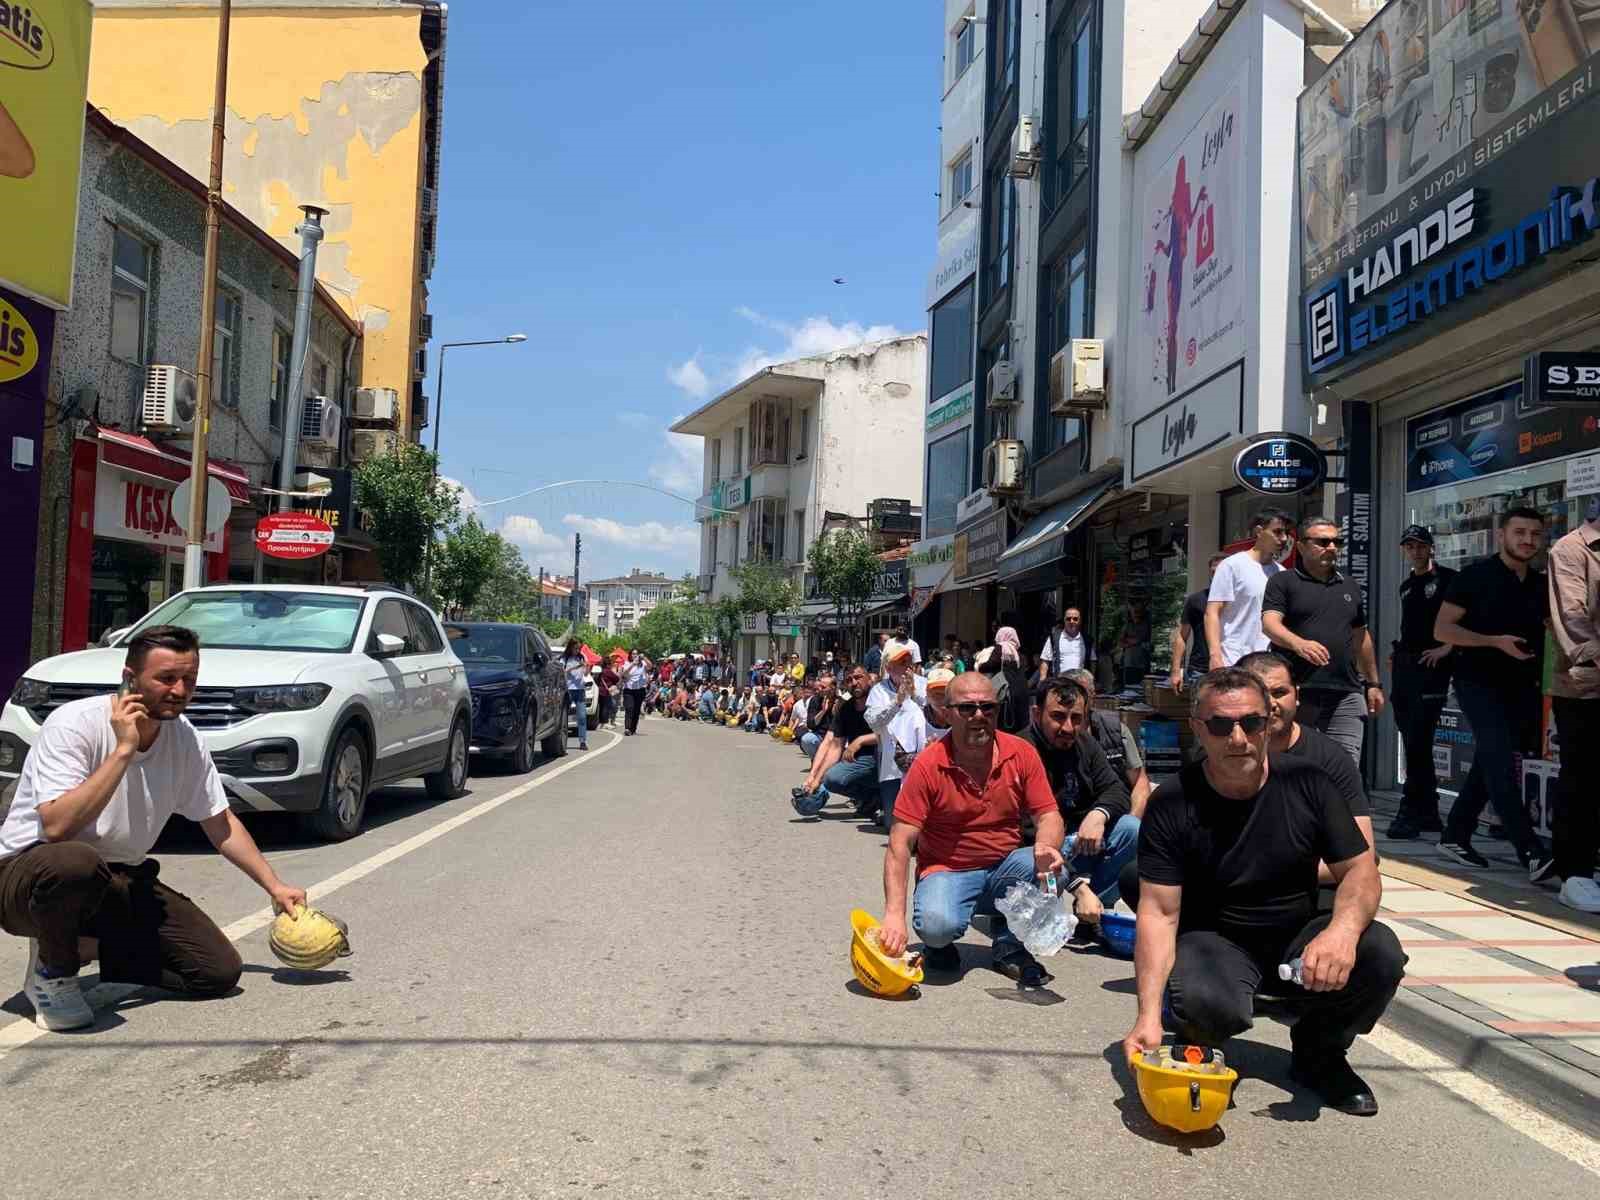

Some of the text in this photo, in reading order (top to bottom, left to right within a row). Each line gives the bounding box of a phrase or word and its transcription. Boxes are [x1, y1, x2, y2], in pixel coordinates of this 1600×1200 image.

[1408, 197, 1418, 212] &
[1424, 160, 1466, 200] UYDU
[1474, 66, 1593, 167] SİSTEMLERİ
[1348, 188, 1474, 304] HANDE
[1257, 459, 1301, 467] HANDE
[744, 616, 757, 629] TEB
